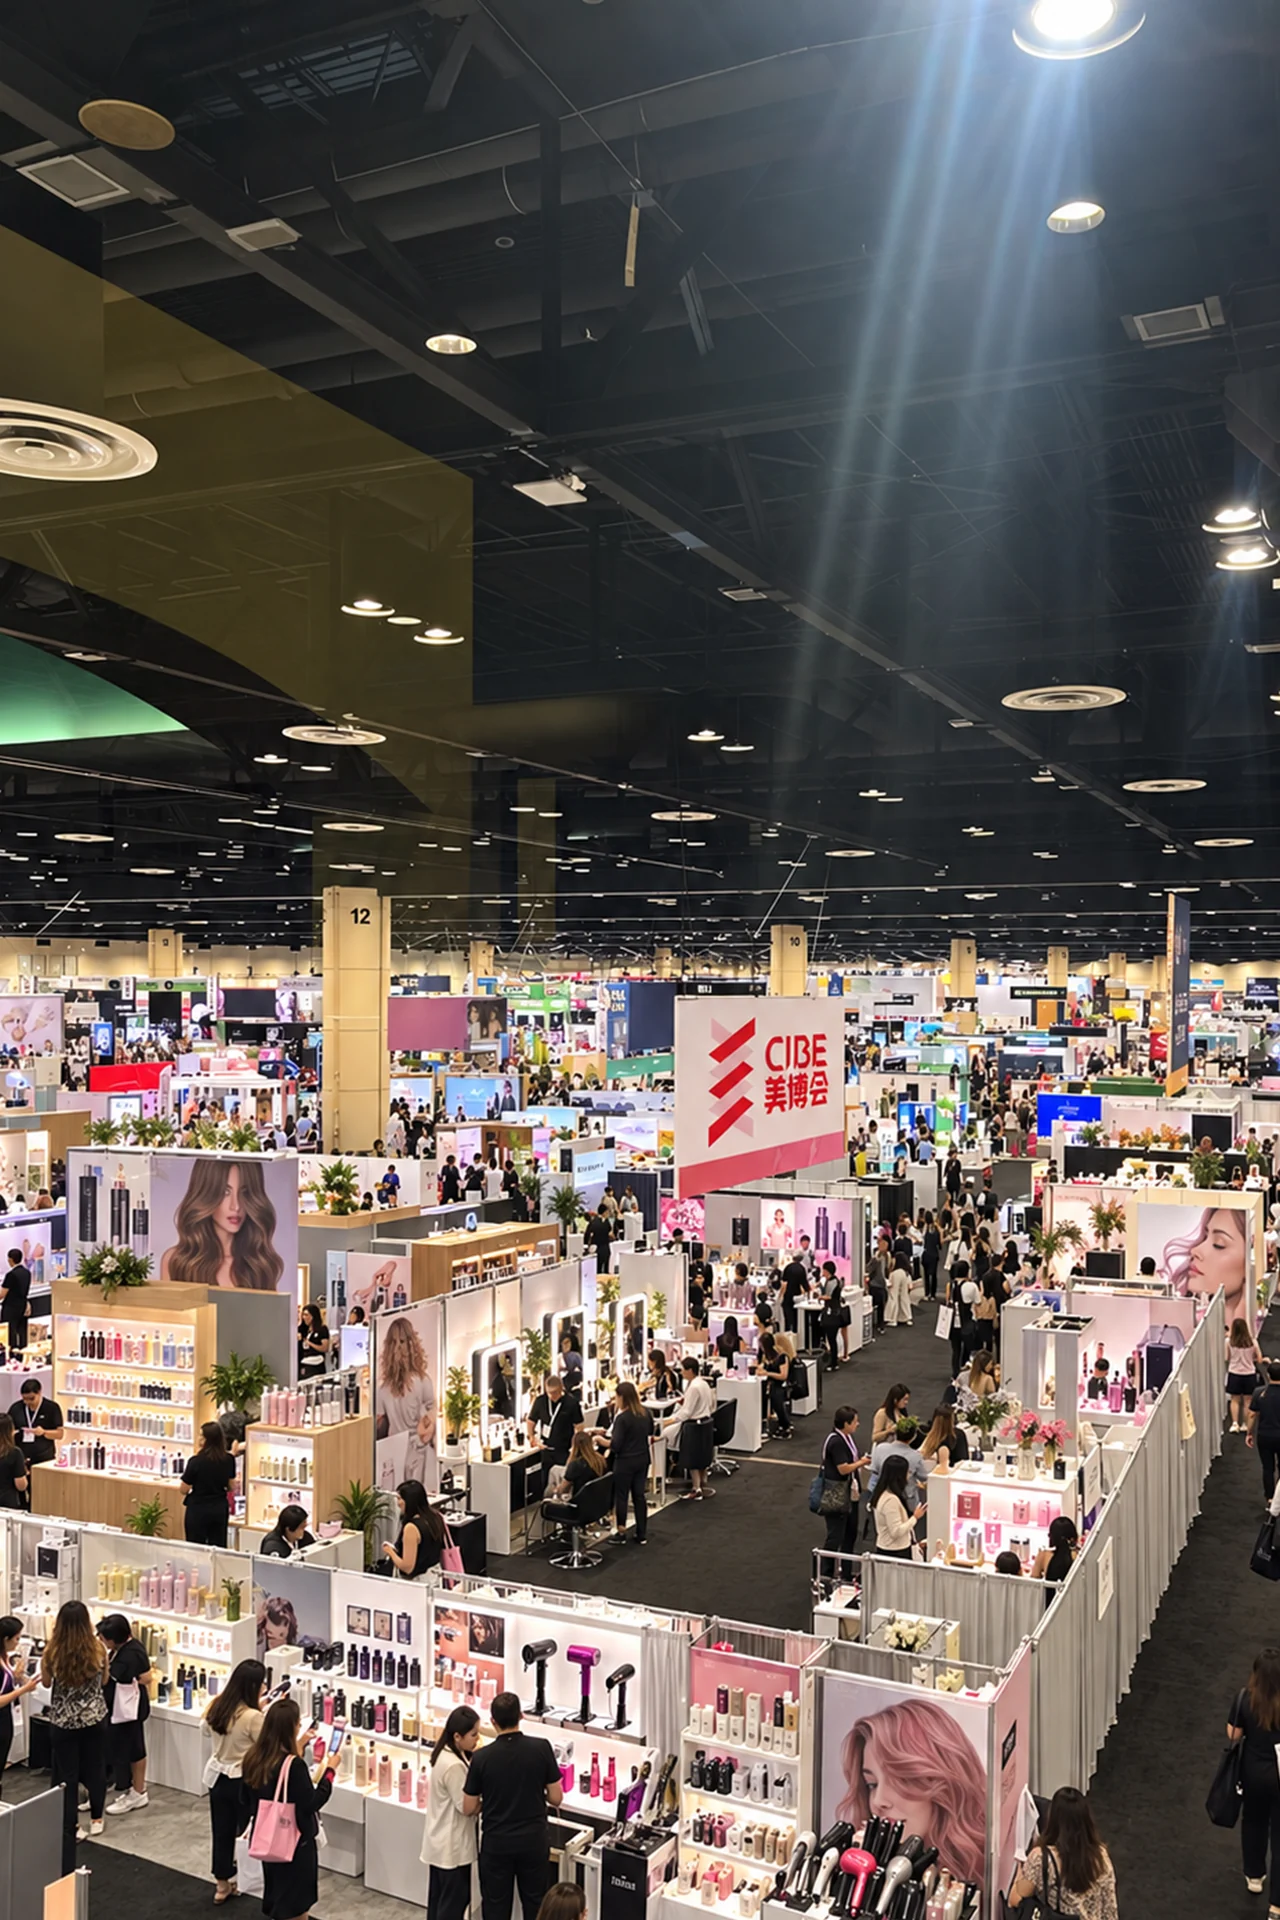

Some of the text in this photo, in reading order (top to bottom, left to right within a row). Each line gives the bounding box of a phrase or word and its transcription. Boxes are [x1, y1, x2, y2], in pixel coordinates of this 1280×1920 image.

[350, 907, 371, 925] 12
[765, 1034, 827, 1072] CIBE
[764, 1071, 828, 1115] 美博会
